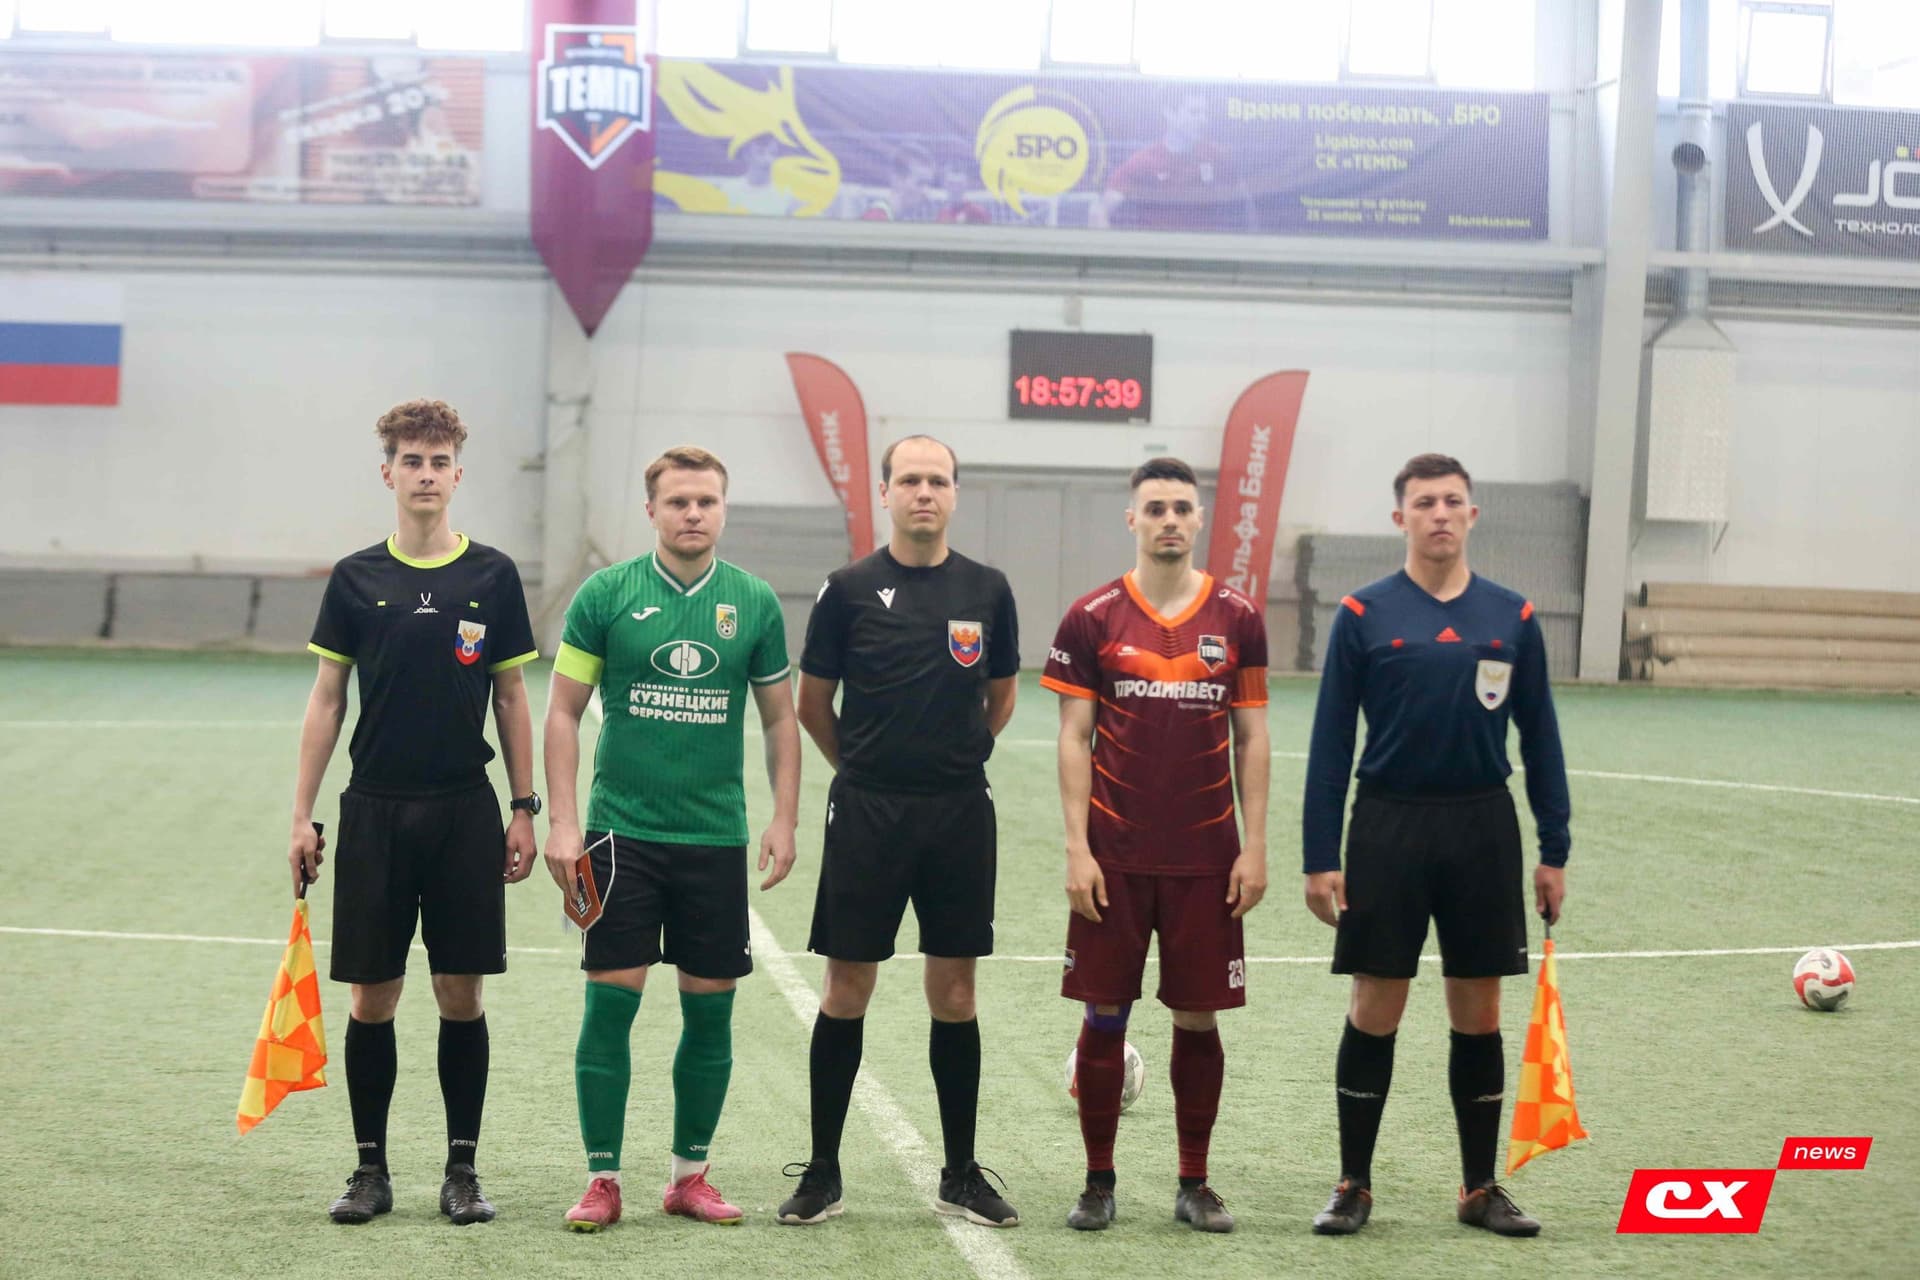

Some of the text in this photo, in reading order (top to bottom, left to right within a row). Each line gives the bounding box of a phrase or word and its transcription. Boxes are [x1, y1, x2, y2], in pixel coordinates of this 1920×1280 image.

[548, 64, 640, 116] ТЕМП
[1228, 97, 1300, 123] Время
[1007, 133, 1078, 160] .БРО
[1015, 375, 1142, 409] 18:57:39
[1238, 424, 1272, 498] Банк
[630, 689, 729, 711] КУЗНЕЦКИЕ
[1114, 680, 1226, 701] ПРОДИНВЕСТ
[629, 705, 727, 724] ФЕРРОСПЛАВЫ
[1228, 958, 1244, 988] 23
